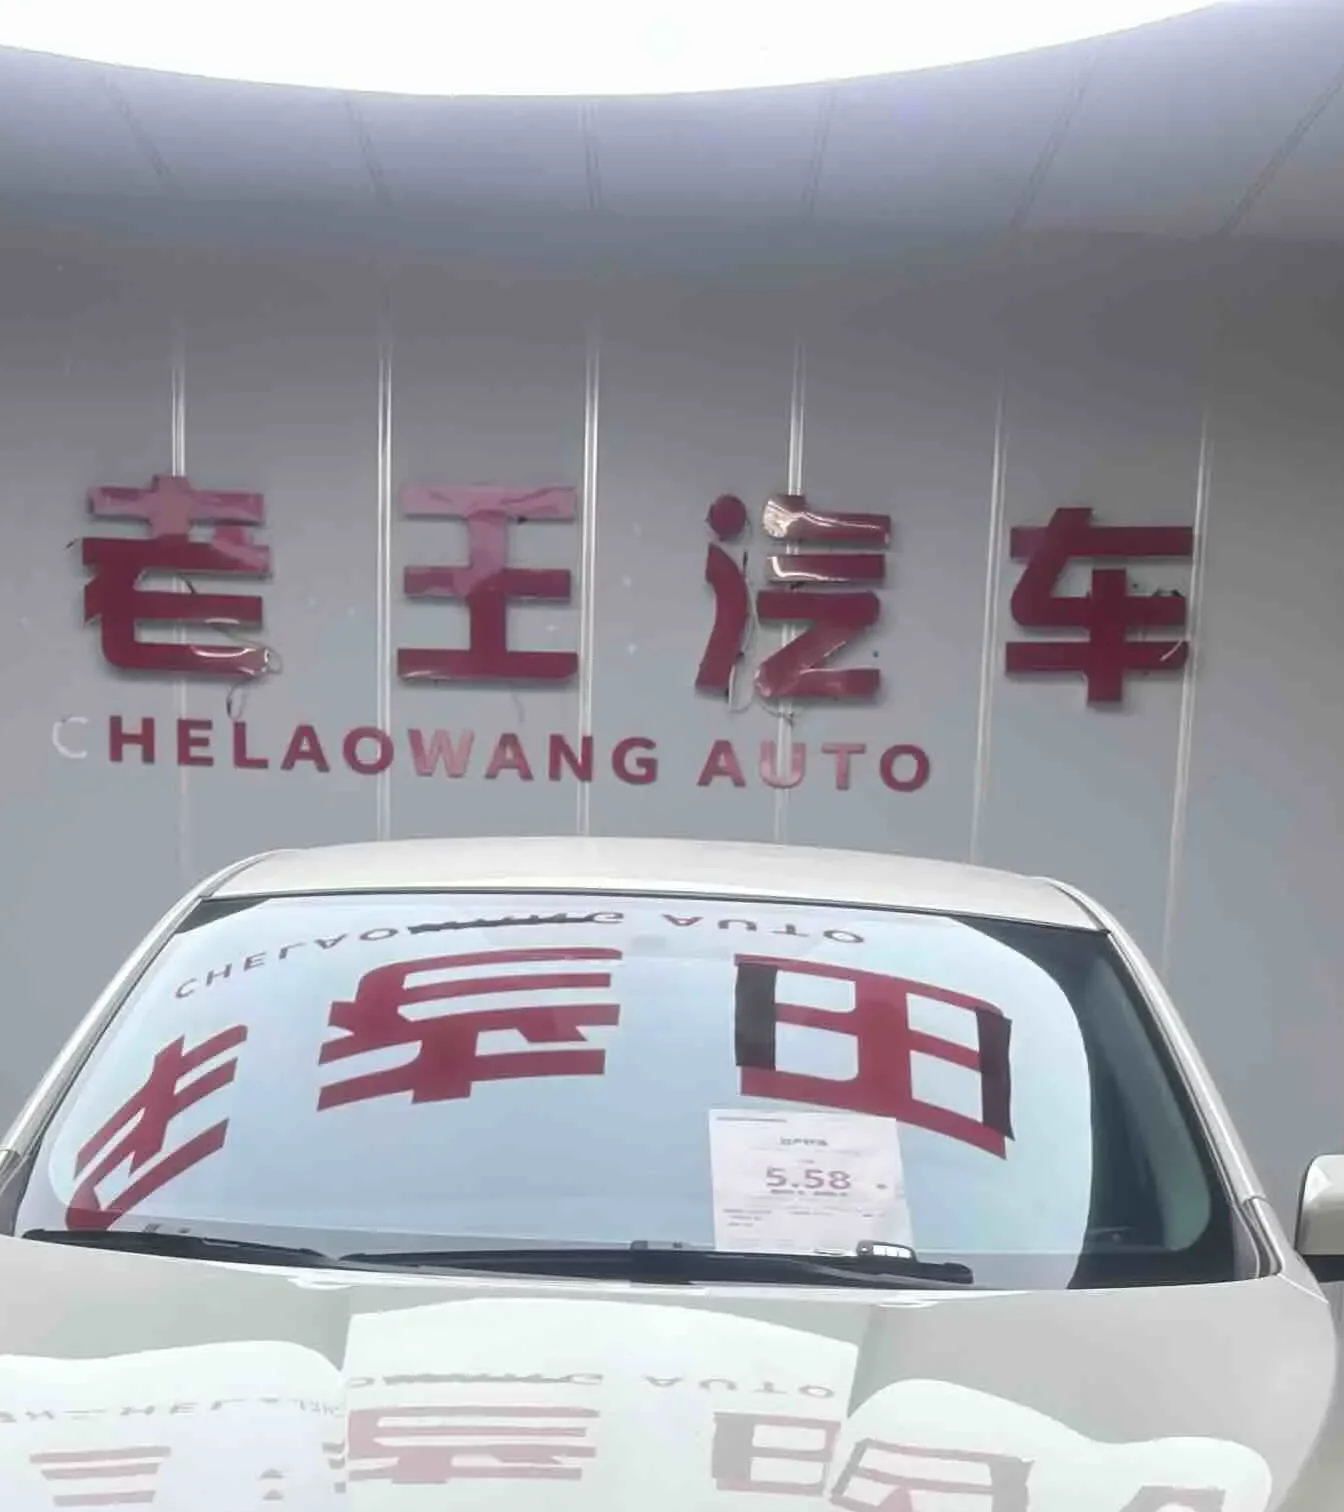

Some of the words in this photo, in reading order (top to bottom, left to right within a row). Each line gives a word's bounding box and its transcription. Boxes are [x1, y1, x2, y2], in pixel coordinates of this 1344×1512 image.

[53, 715, 659, 786] CHELAOWANG
[696, 740, 931, 793] AUTO
[765, 1166, 852, 1191] 5.58
